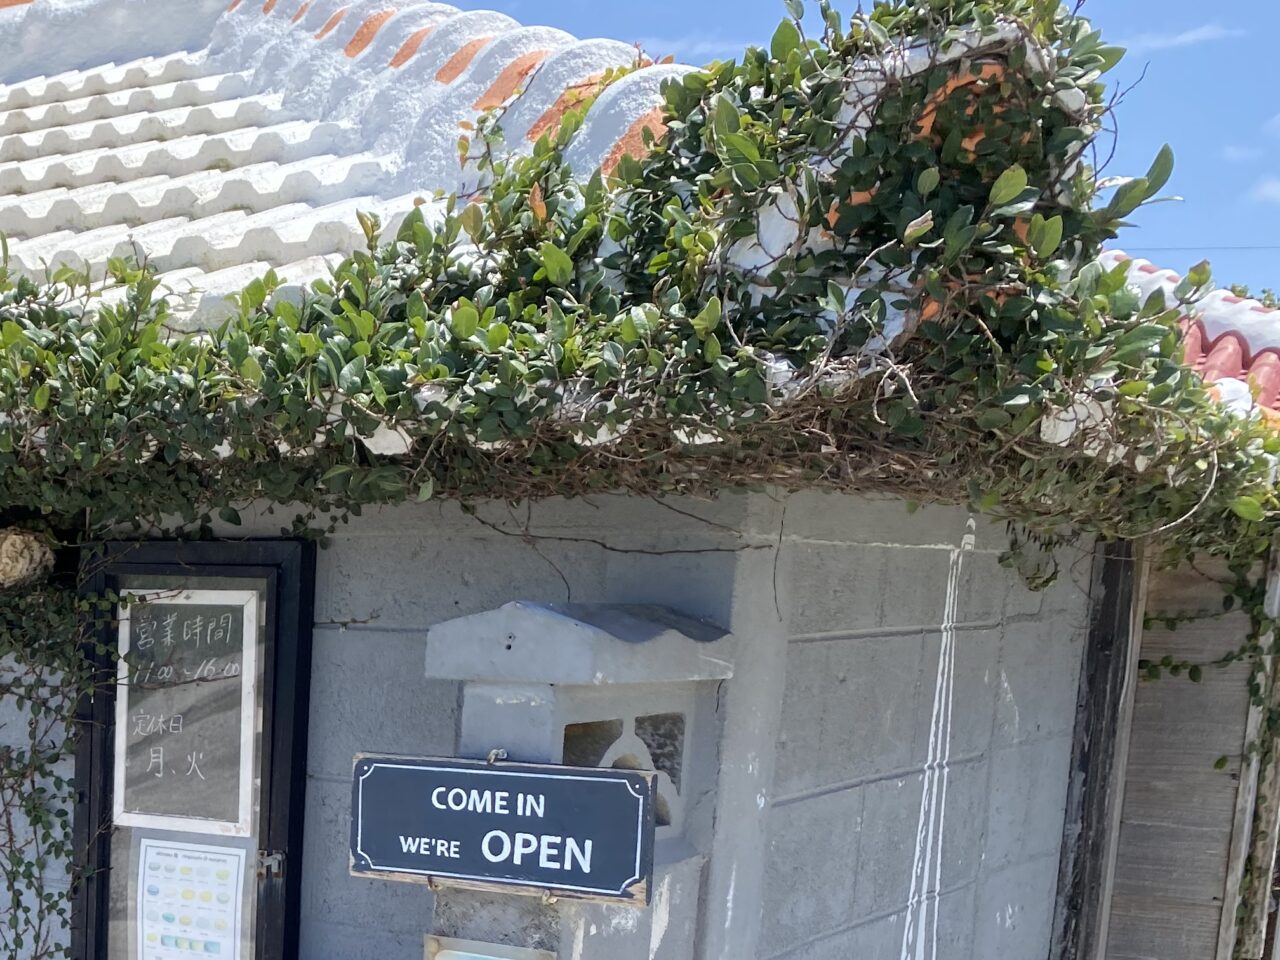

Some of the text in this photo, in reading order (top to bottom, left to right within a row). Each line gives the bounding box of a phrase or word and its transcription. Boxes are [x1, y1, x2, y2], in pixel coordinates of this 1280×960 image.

[135, 611, 232, 650] 営業時間
[132, 708, 184, 737] 定休日
[431, 786, 545, 818] COME IN
[399, 829, 593, 874] WE'RE OPEN
